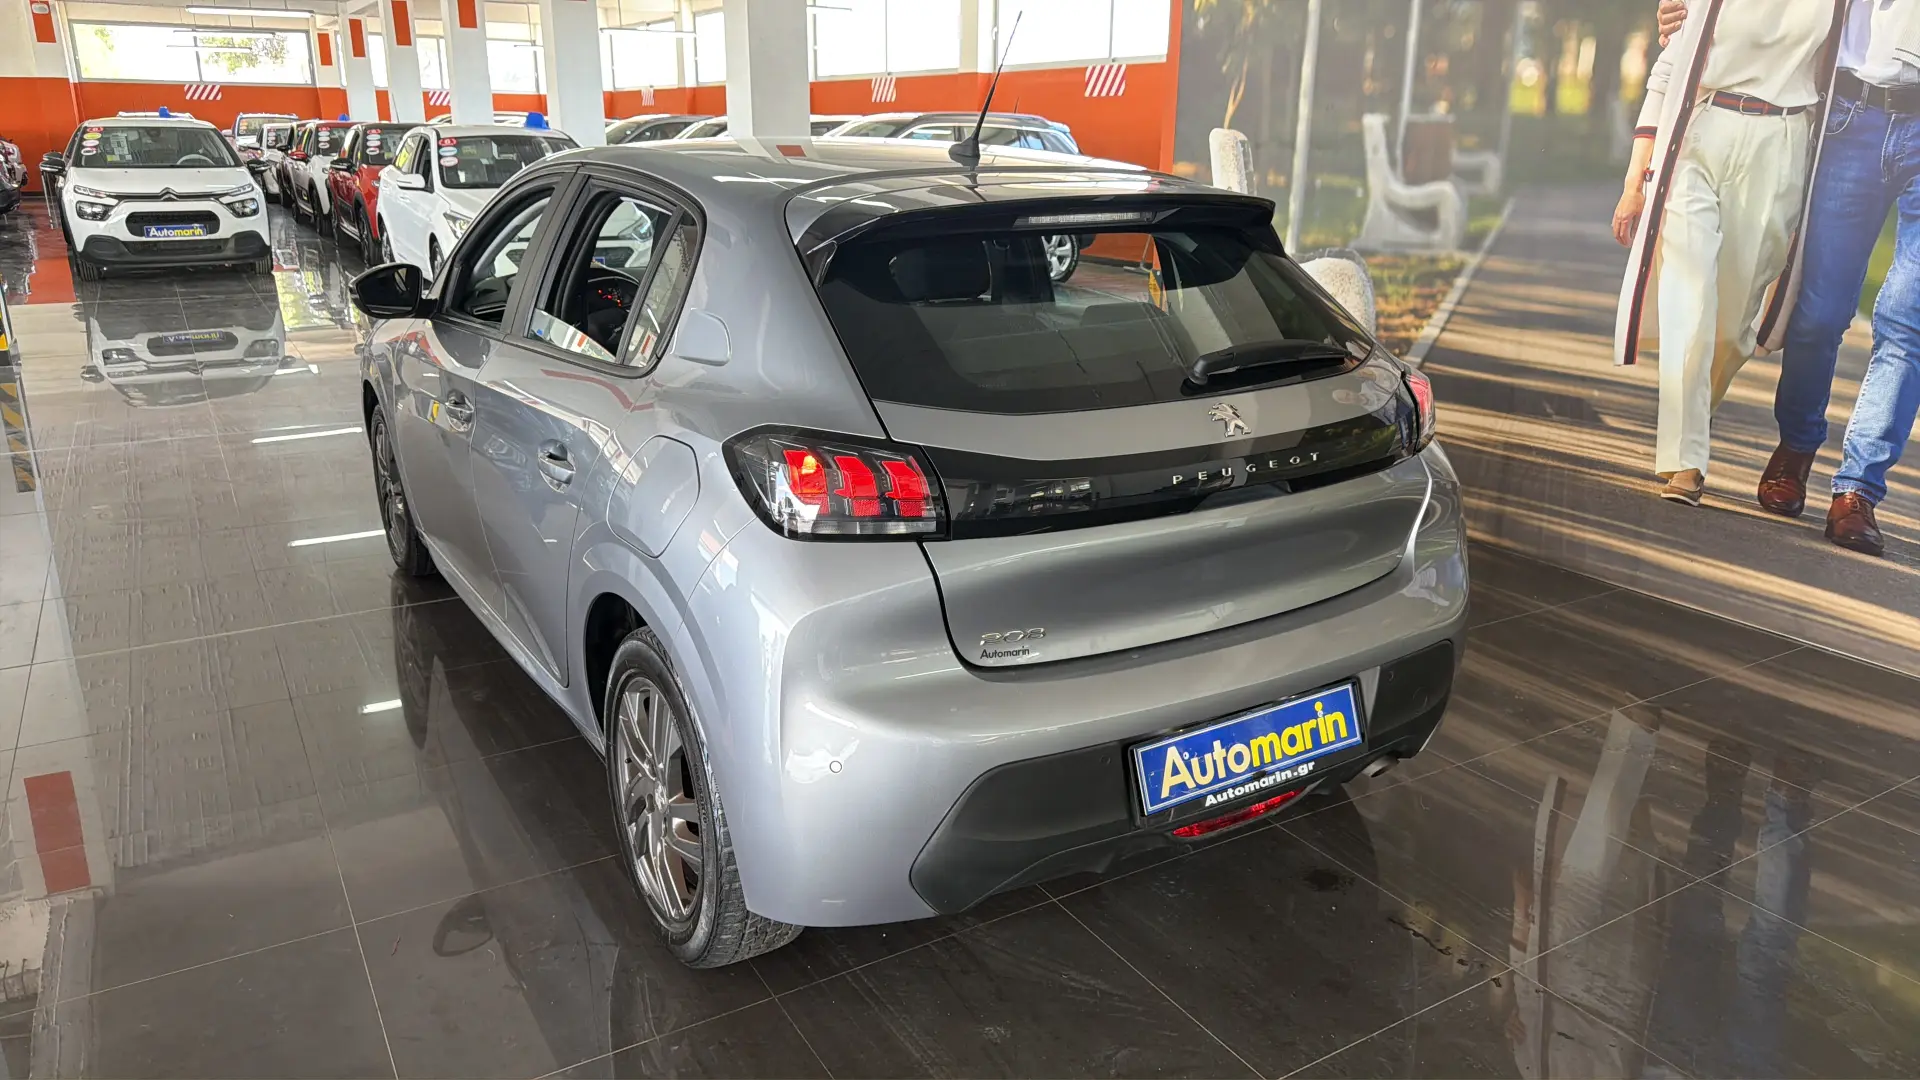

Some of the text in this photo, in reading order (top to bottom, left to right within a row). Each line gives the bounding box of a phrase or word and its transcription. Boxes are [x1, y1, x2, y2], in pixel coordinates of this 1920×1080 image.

[149, 225, 204, 237] Automarin
[1172, 451, 1320, 485] PEUGEOT
[979, 627, 1047, 646] 208
[979, 645, 1031, 660] Automarin
[1160, 701, 1348, 799] Automarin
[1204, 760, 1316, 808] Automarin.gr
